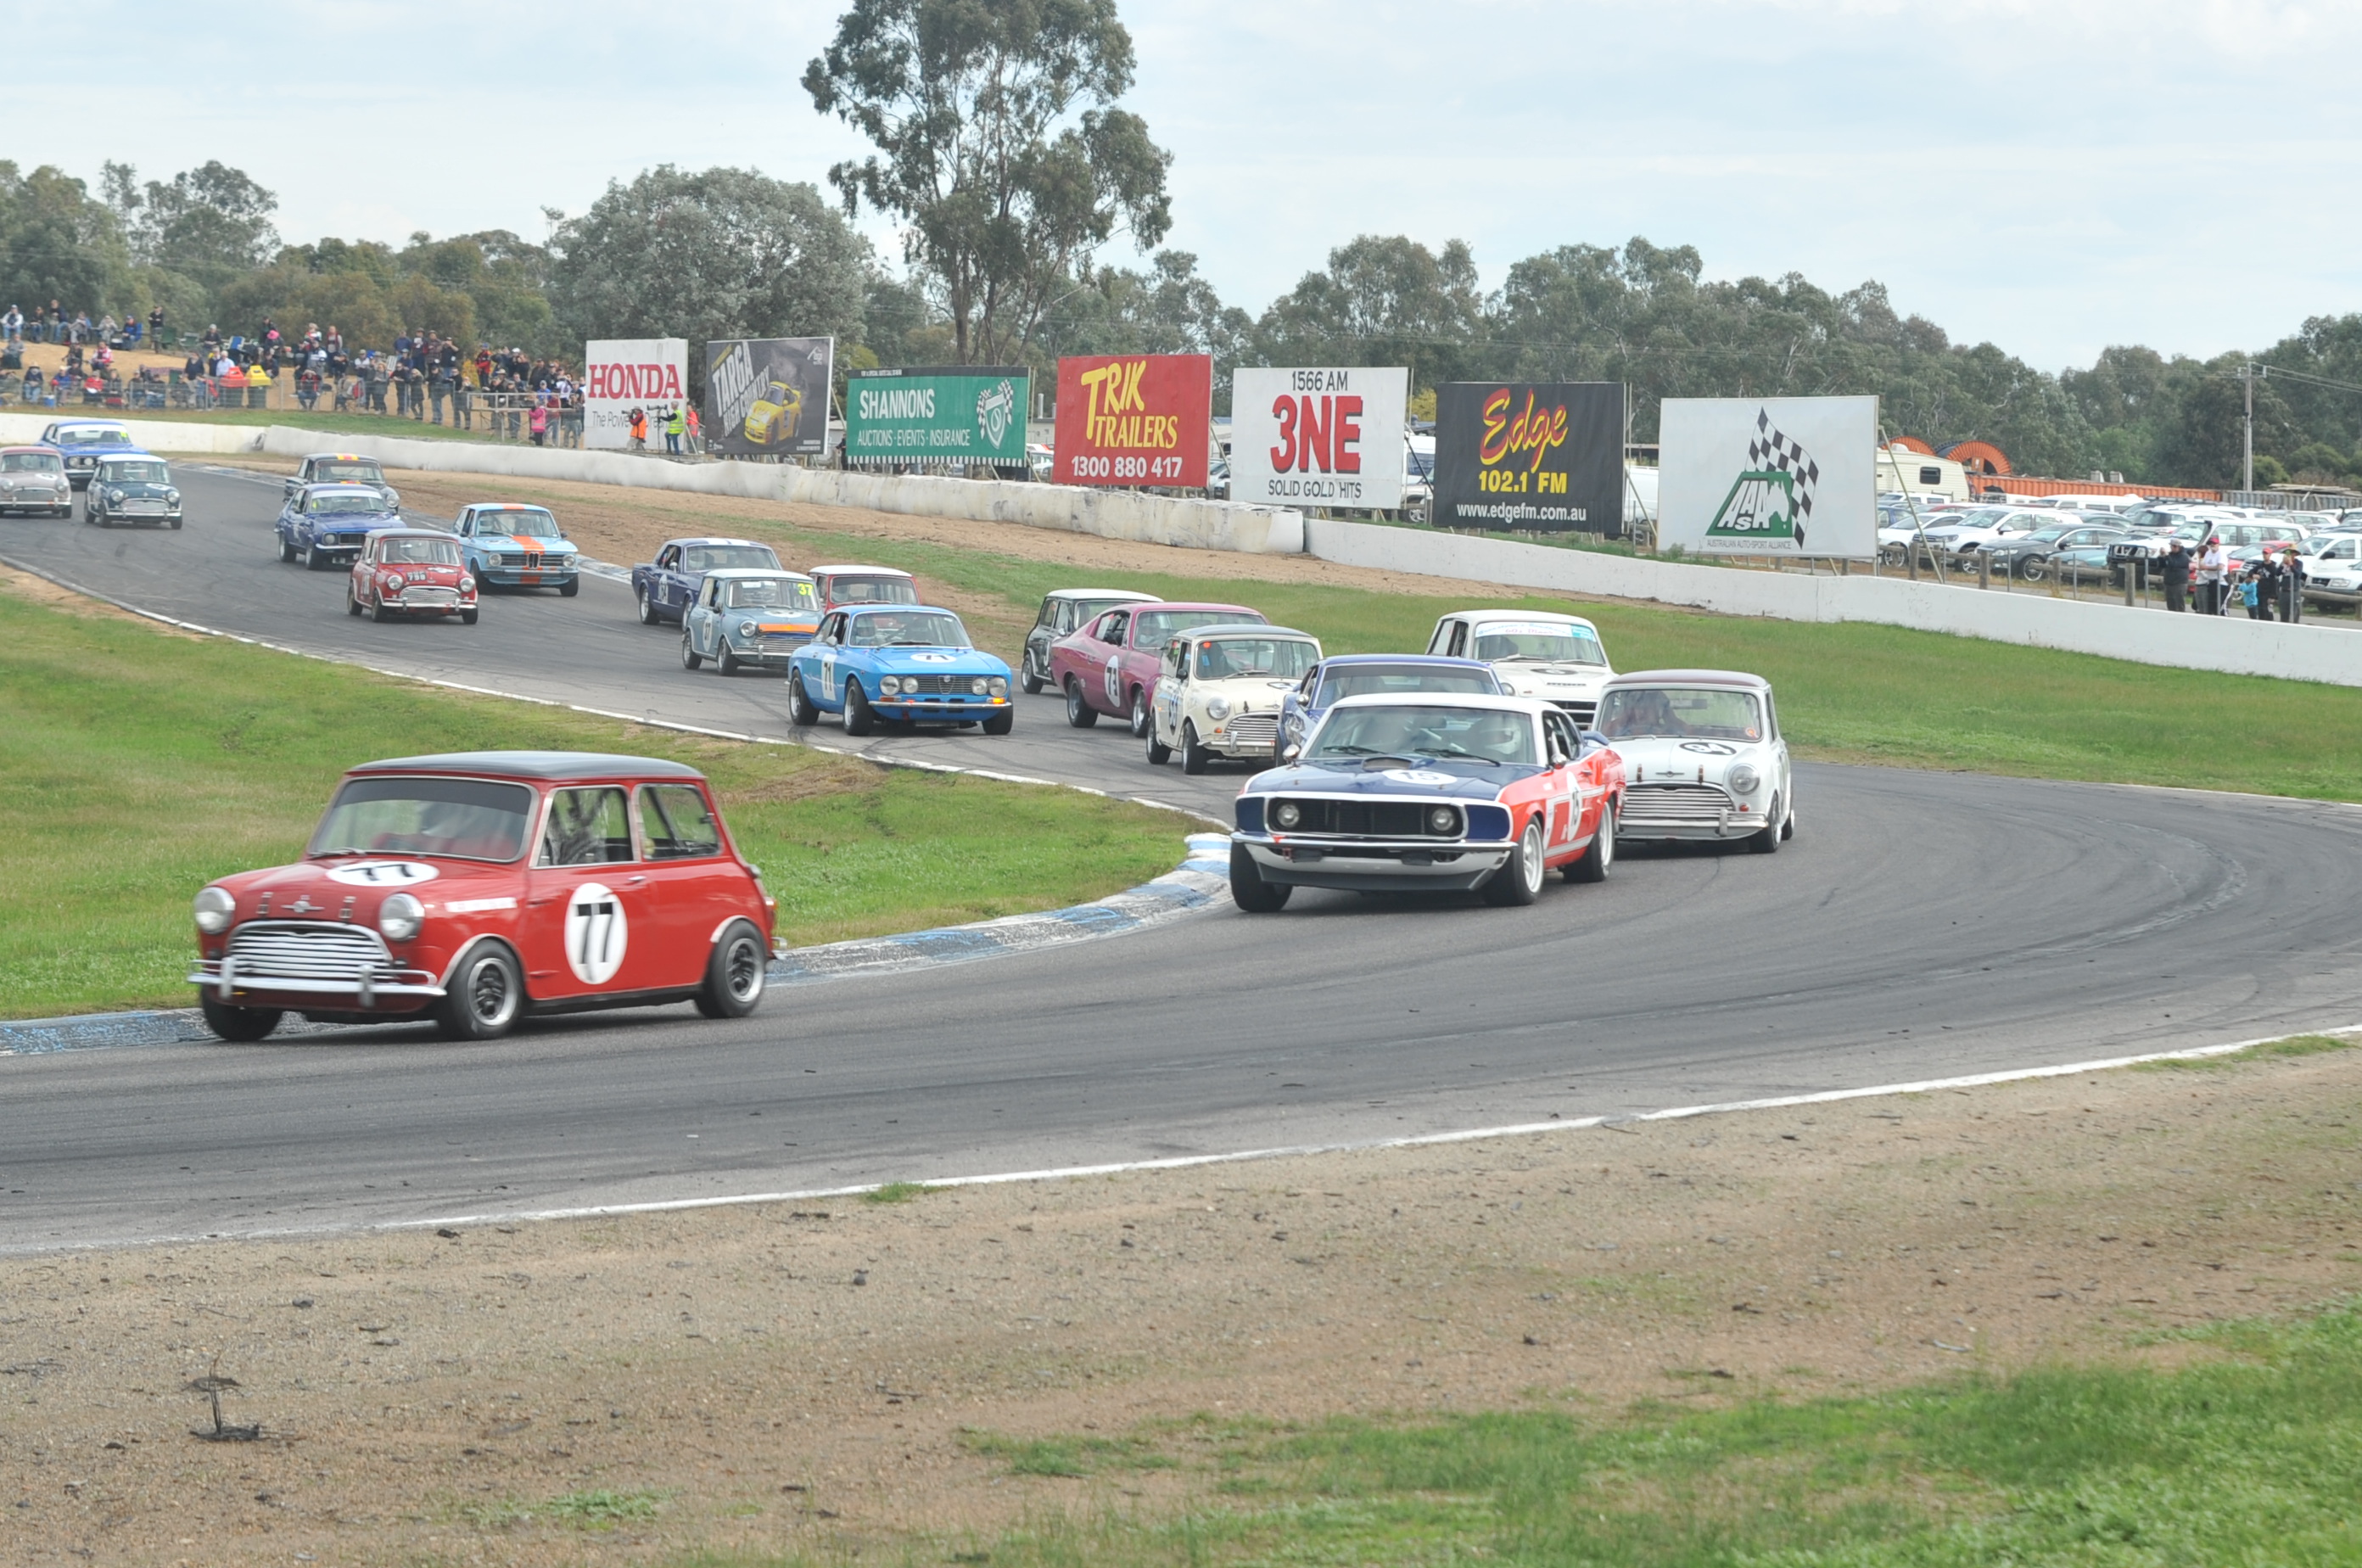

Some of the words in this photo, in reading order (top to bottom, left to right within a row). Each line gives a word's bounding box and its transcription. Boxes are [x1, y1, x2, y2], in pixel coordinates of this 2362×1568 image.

[588, 363, 683, 400] HONDA
[712, 341, 754, 418] TARGA
[1292, 371, 1324, 391] 1566
[1325, 371, 1348, 391] AM
[859, 389, 935, 419] SHANNONS
[1081, 360, 1146, 440] TRIK
[592, 411, 606, 428] The
[607, 411, 630, 428] Powe
[1094, 415, 1178, 449] TRAILERS
[1480, 387, 1569, 473] Edge
[857, 429, 893, 446] AUCTIONS
[897, 429, 926, 446] EVENTS
[929, 429, 971, 446] INSURANCE
[1270, 394, 1363, 474] 3NE
[1072, 456, 1111, 478] 1300
[1114, 456, 1147, 478] 880
[1151, 456, 1183, 478] 417
[1268, 479, 1301, 496] SOLID
[1303, 480, 1335, 497] GOLD
[1339, 481, 1362, 499] HITS
[1479, 469, 1527, 493] 102.1
[1537, 472, 1567, 494] FM
[1457, 501, 1587, 524] www.edgefm.com.au
[1707, 539, 1737, 548] AUSTRALIAN
[1768, 540, 1792, 550] ALLIANCE
[797, 583, 813, 596] 37
[824, 662, 832, 692] 71
[1106, 666, 1118, 697] 73
[1398, 771, 1440, 781] 15
[341, 864, 415, 882] 77
[575, 901, 614, 965] 77
